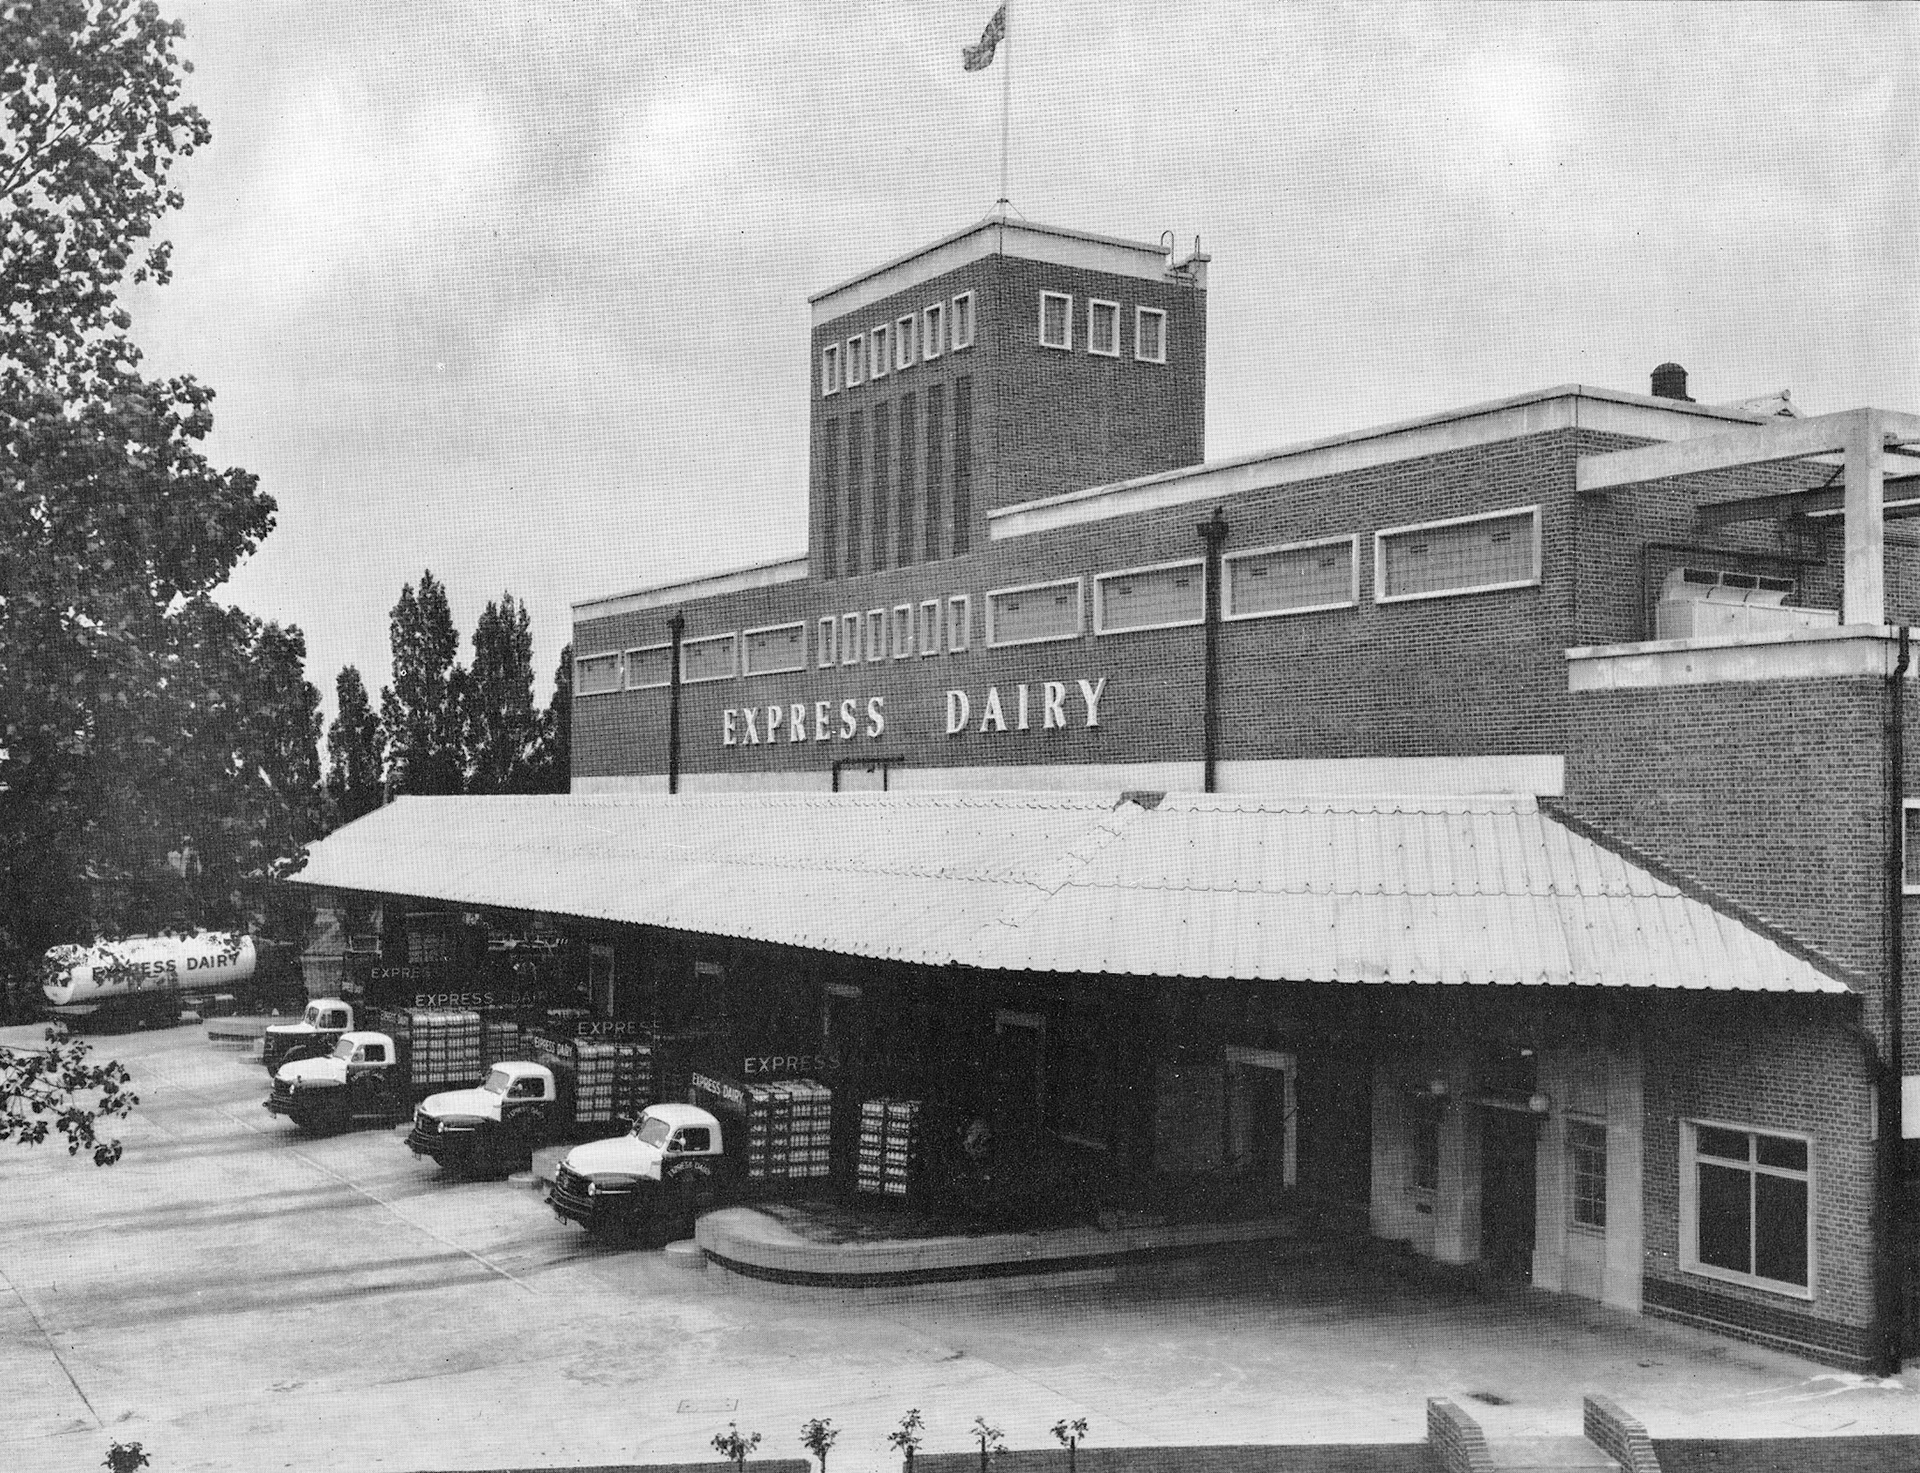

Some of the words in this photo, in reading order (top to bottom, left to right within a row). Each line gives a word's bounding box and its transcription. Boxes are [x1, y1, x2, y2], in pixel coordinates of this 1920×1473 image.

[722, 696, 886, 746] EXPRESS
[945, 676, 1106, 735] DAIRY
[186, 952, 240, 971] DAIRY
[414, 992, 494, 1007] EXPRESS
[744, 1055, 841, 1074] EXPRESS
[692, 1072, 721, 1095] EXPRESS
[722, 1085, 745, 1103] DAIRY
